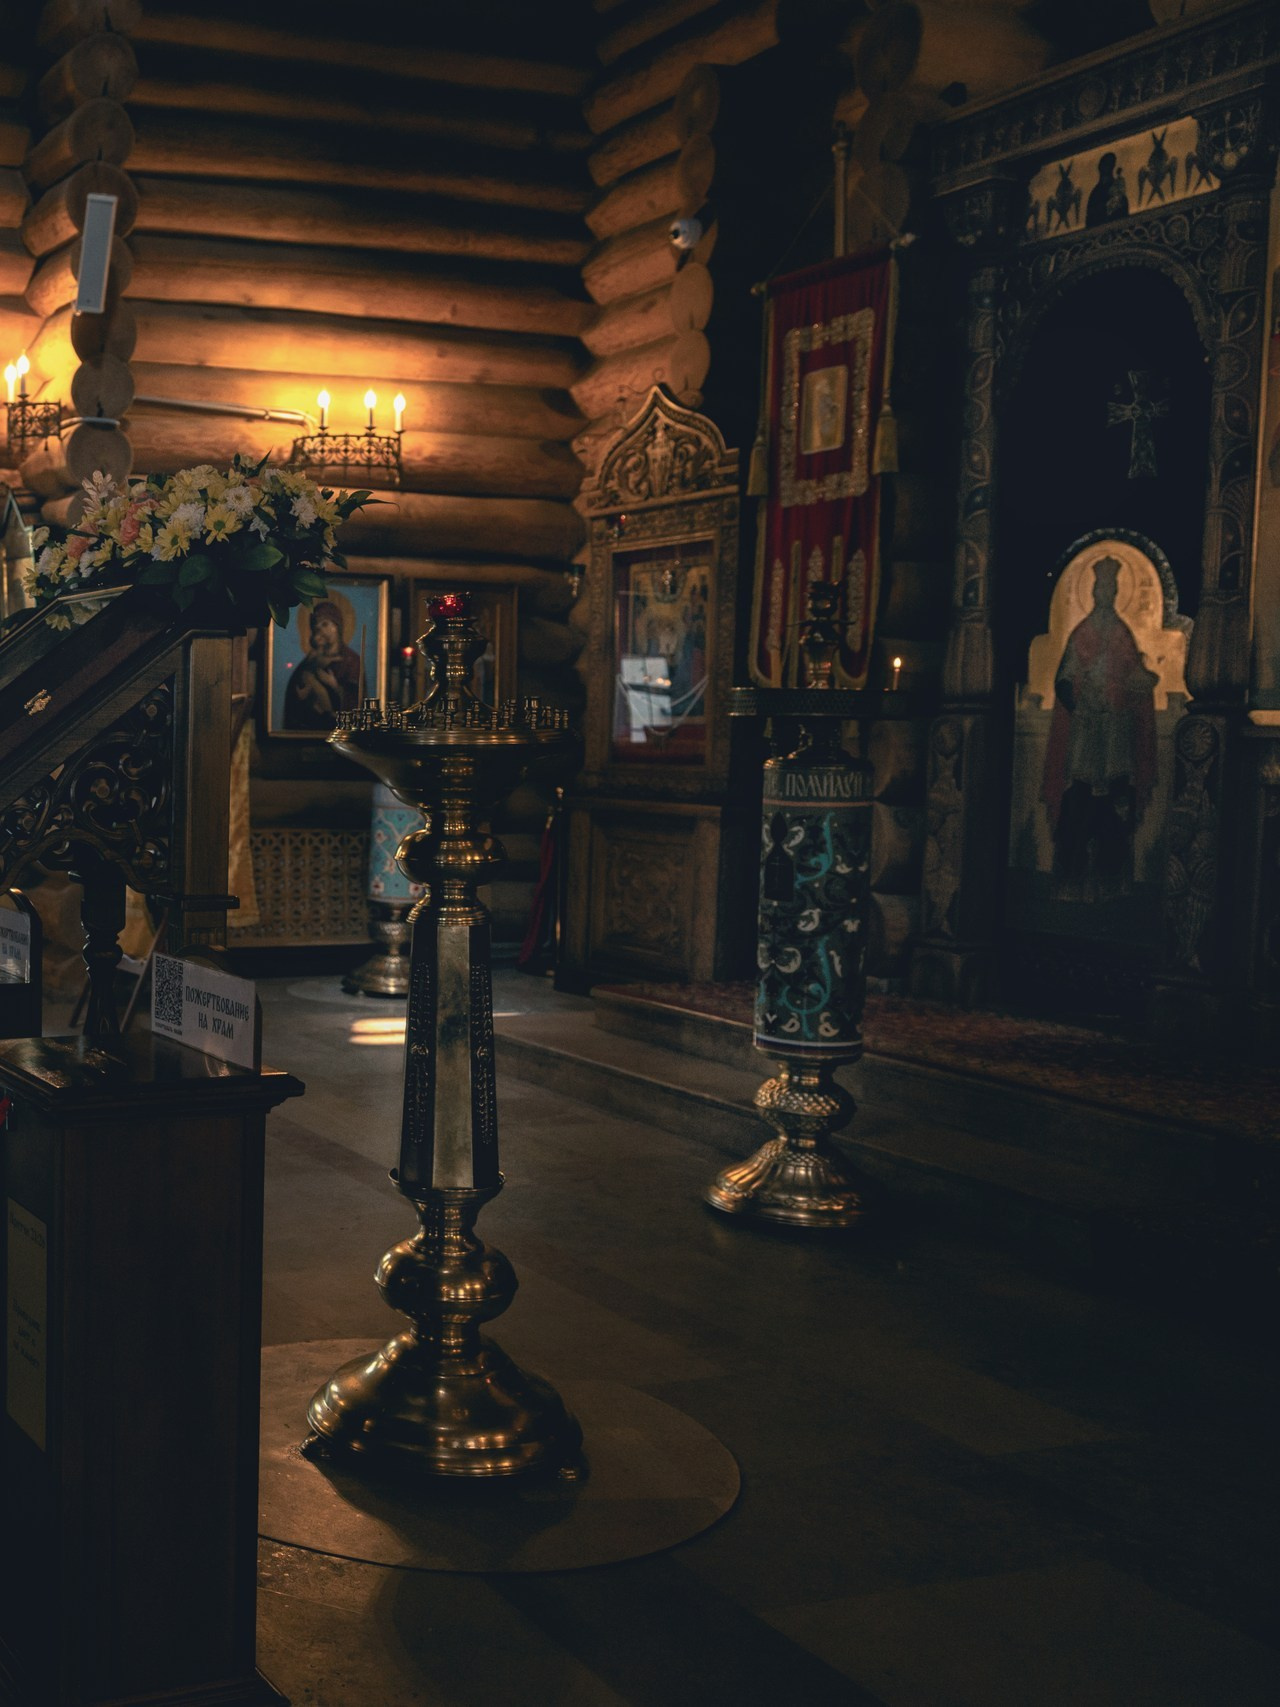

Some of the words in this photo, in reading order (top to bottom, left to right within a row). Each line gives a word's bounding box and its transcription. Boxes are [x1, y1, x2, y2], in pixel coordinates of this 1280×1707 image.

[185, 985, 249, 1021] ПОЖЕРТВОВАНИЕ
[198, 1012, 208, 1029] НА
[212, 1017, 234, 1040] ХРАМ
